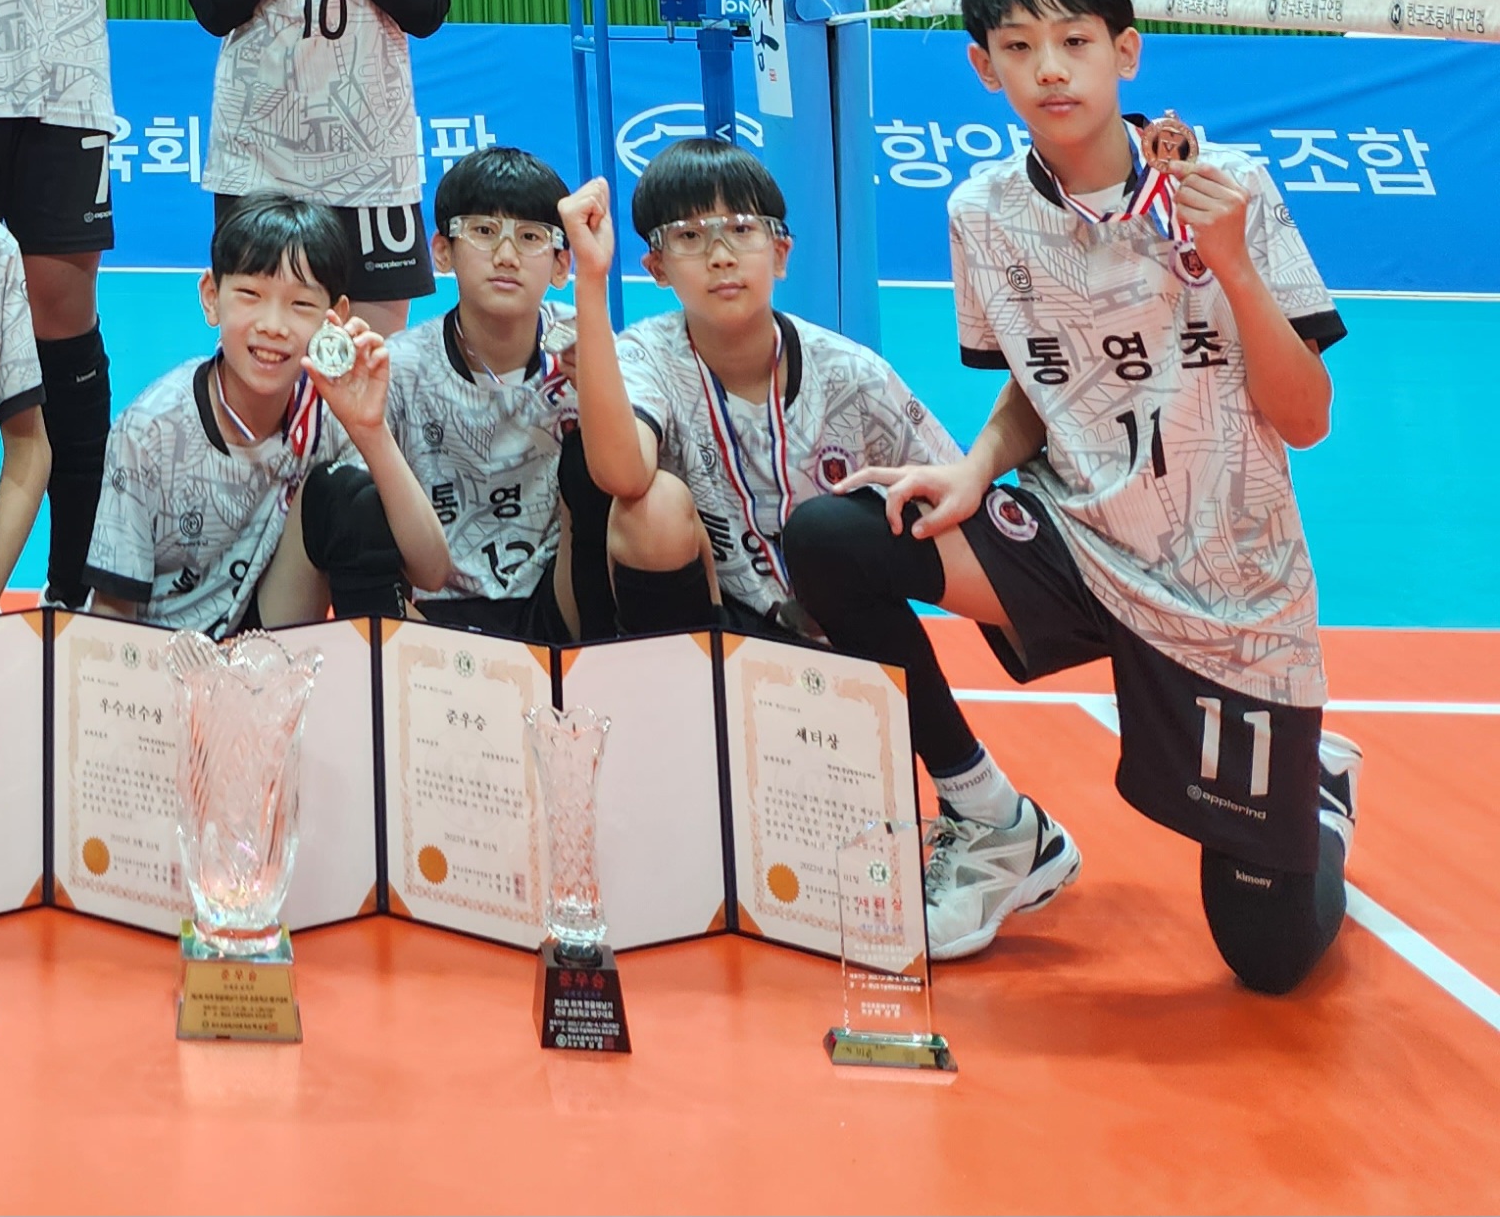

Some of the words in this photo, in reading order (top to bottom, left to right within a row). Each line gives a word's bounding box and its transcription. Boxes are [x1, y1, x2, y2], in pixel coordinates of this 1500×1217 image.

[81, 134, 110, 205] 7
[356, 206, 417, 256] 10
[1115, 405, 1169, 479] 11
[1195, 696, 1272, 797] 11
[1202, 791, 1267, 821] applerind
